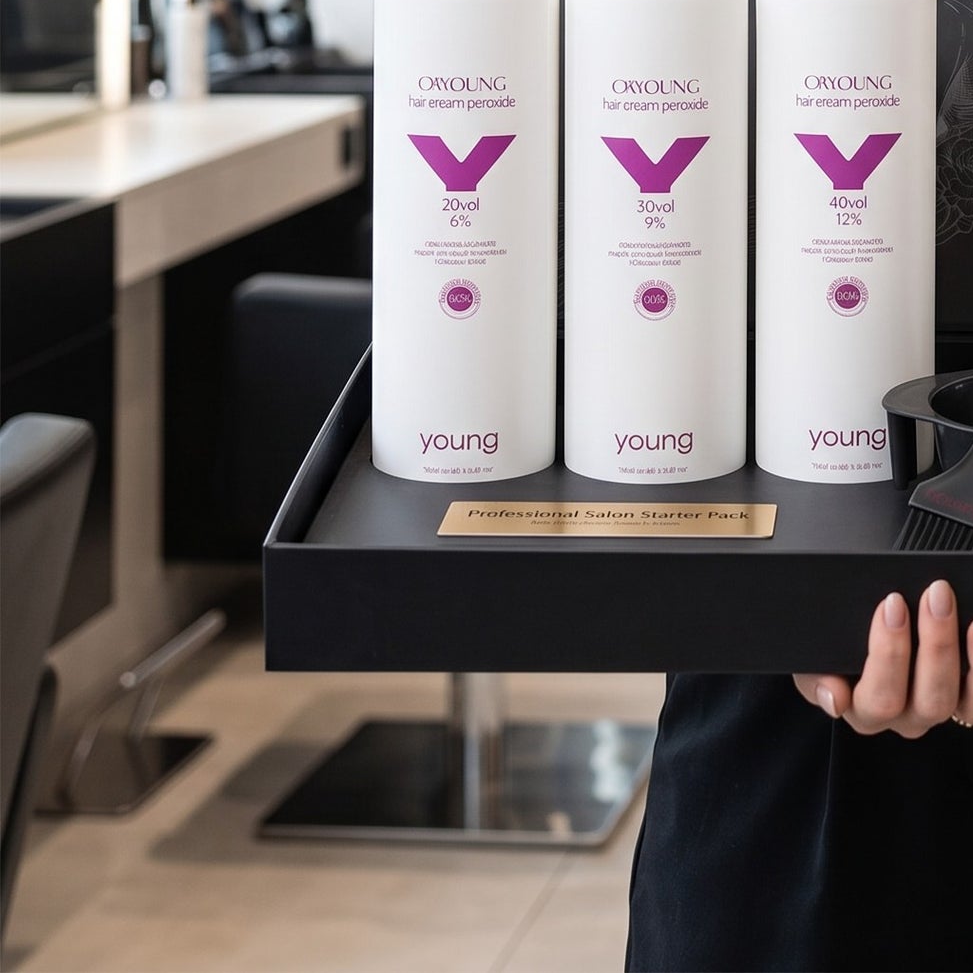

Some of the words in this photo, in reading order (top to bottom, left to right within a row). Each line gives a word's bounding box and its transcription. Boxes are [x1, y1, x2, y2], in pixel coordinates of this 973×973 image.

[408, 95, 427, 108] hair
[467, 95, 516, 111] peroxide
[603, 98, 621, 110] hair
[662, 98, 709, 114] peroxide
[796, 94, 814, 107] hair
[854, 95, 900, 110] peroxide
[442, 197, 479, 211] 20vol
[637, 199, 675, 213] 30vol
[829, 195, 867, 209] 40vol
[450, 214, 472, 228] 6%
[644, 216, 666, 229] 9%
[837, 212, 862, 226] 12%
[420, 432, 499, 455] young
[615, 432, 693, 455] young
[809, 428, 887, 451] young
[468, 509, 579, 520] Professional
[585, 510, 634, 520] Salon
[641, 510, 702, 520] Starter
[708, 511, 750, 520] Pack
